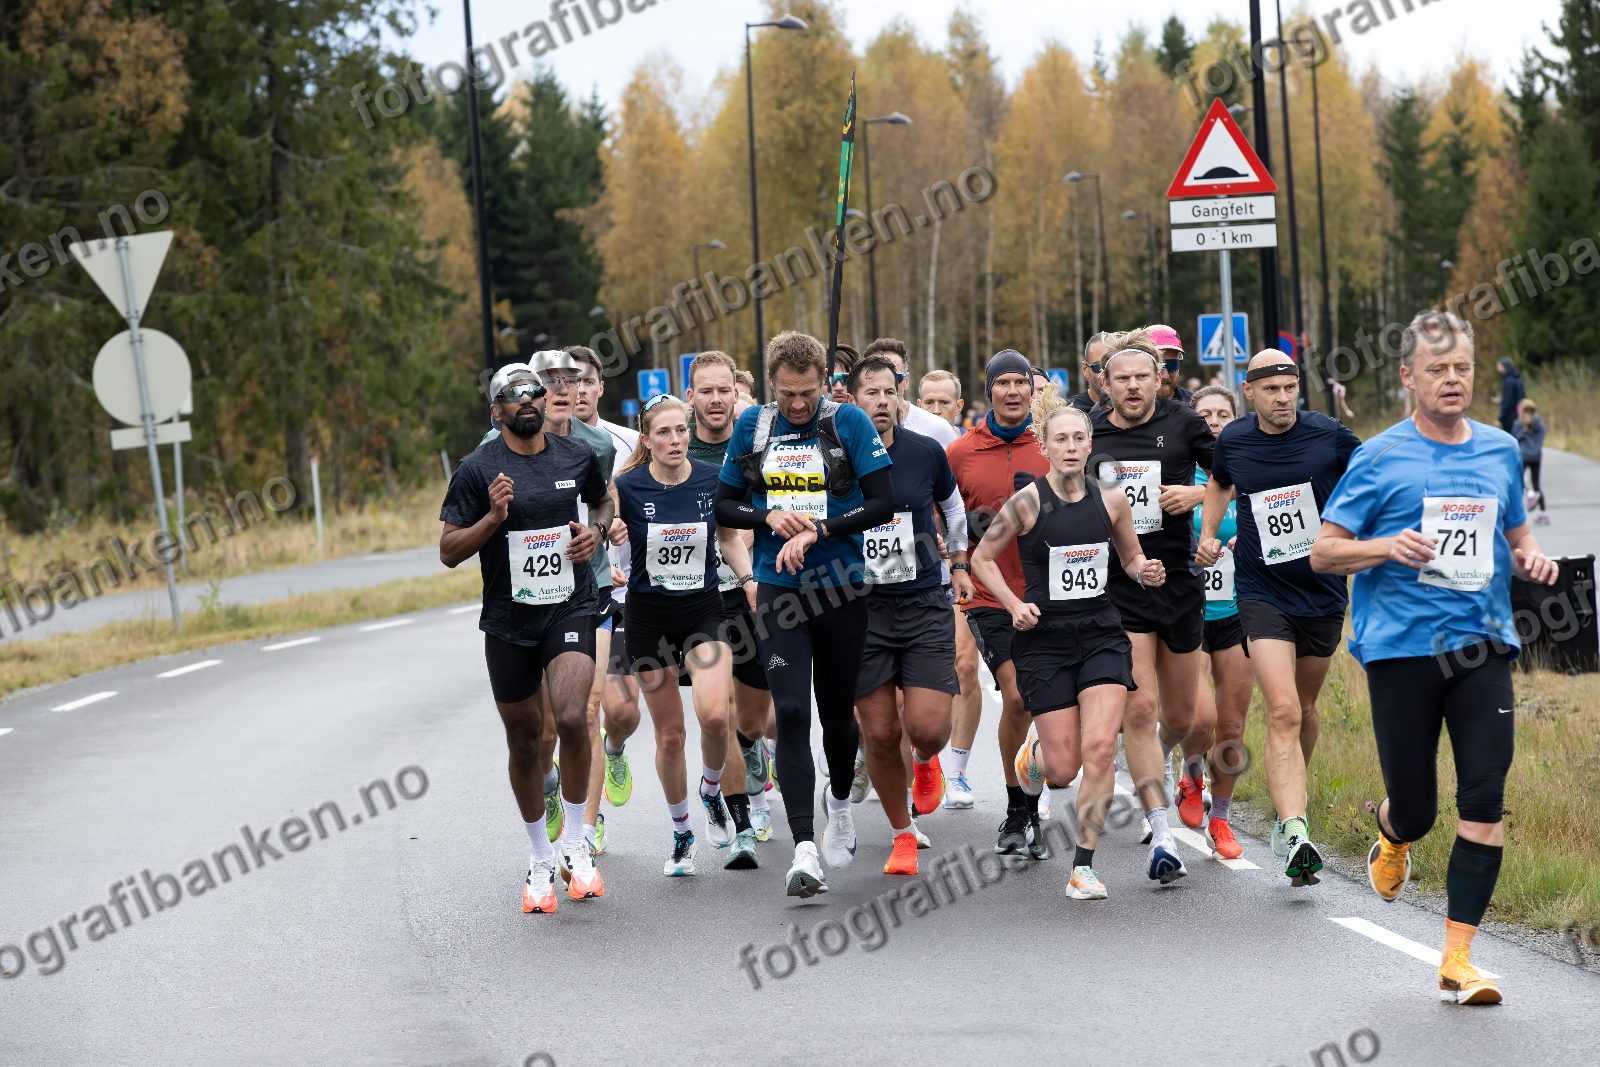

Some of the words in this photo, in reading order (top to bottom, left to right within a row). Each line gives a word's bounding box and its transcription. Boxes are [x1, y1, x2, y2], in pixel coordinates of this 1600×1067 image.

[1192, 202, 1255, 219] Gangfelt
[776, 454, 813, 462] NORGES
[1113, 465, 1150, 473] NORGES
[1264, 490, 1301, 503] NORGES
[789, 502, 824, 512] Aurskog
[1268, 498, 1296, 510] LØPET
[1441, 504, 1485, 512] NORGES
[1444, 512, 1477, 520] LØPET
[1267, 509, 1305, 537] 891
[523, 533, 561, 543] NORGES
[1437, 529, 1477, 556] 721
[528, 540, 556, 550] LØPET
[866, 537, 902, 559] 854
[657, 546, 696, 565] 397
[1064, 548, 1099, 558] NORGES
[523, 553, 562, 577] 429
[671, 573, 703, 583] Aurskog
[1061, 568, 1099, 591] 943
[1452, 569, 1491, 582] Aurskog
[538, 585, 573, 596] Aurskog
